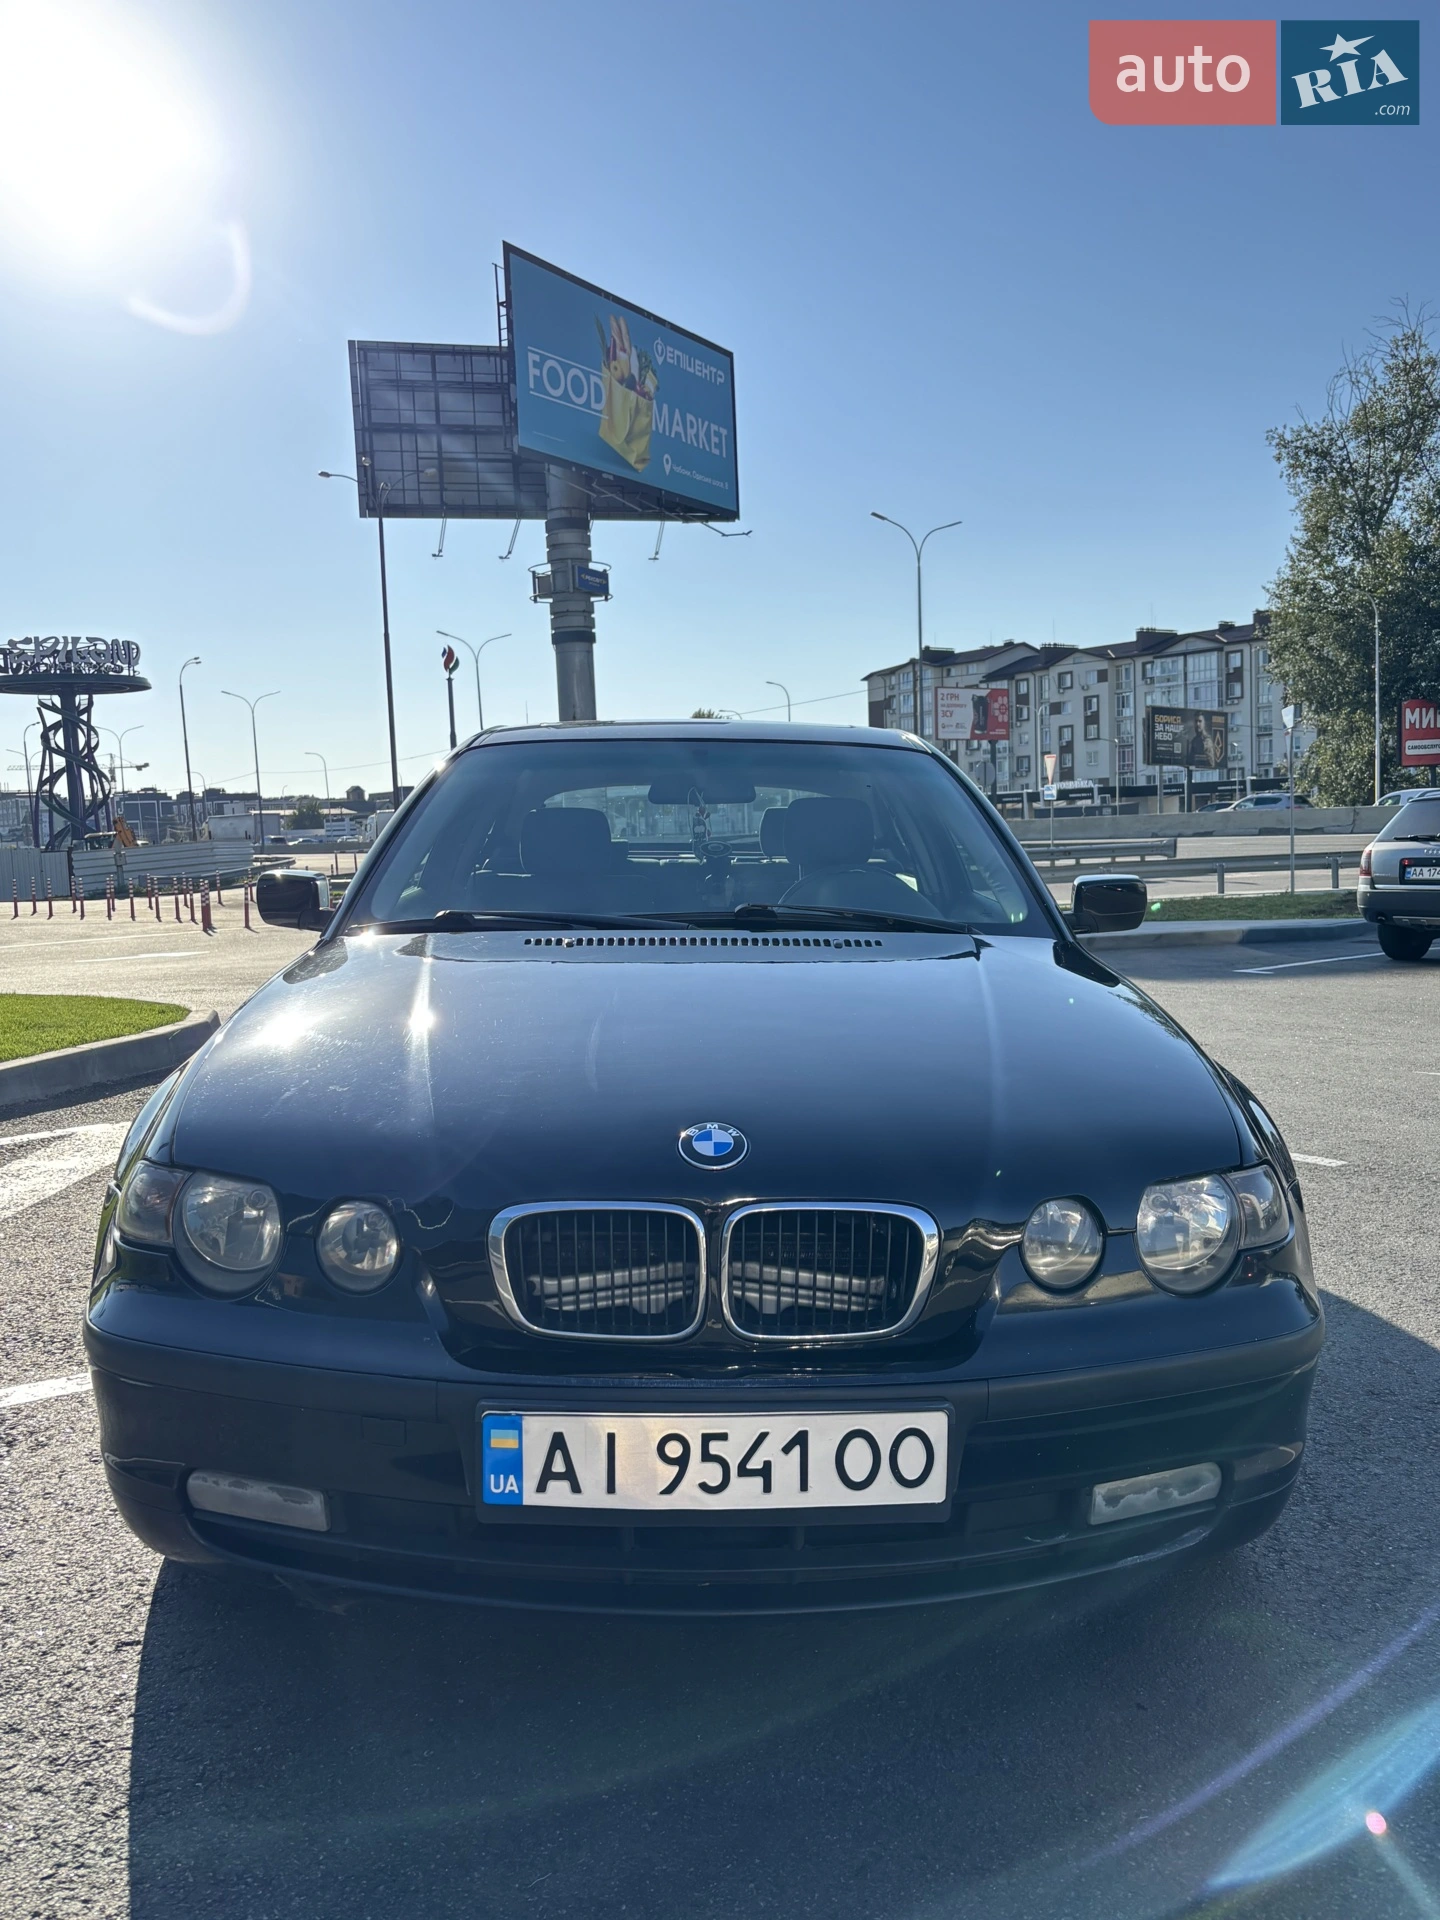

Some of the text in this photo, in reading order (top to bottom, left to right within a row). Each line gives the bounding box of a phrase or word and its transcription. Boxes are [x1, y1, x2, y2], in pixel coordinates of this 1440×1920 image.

[666, 345, 725, 386] ЕПІЦЕНТР
[527, 351, 606, 411] FOOD
[652, 398, 728, 458] MARKET
[946, 692, 960, 701] ГРН
[940, 709, 954, 718] ЗСУ
[1154, 714, 1182, 724] БОРИСЯ
[1405, 707, 1440, 729] МИ
[1154, 723, 1185, 733] ЗА НАШЕ
[1154, 732, 1173, 741] НЕБО
[1411, 868, 1424, 877] AA
[686, 1123, 740, 1137] BMW
[535, 1431, 617, 1494] AI
[656, 1430, 809, 1495] 9541
[490, 1474, 520, 1493] UA
